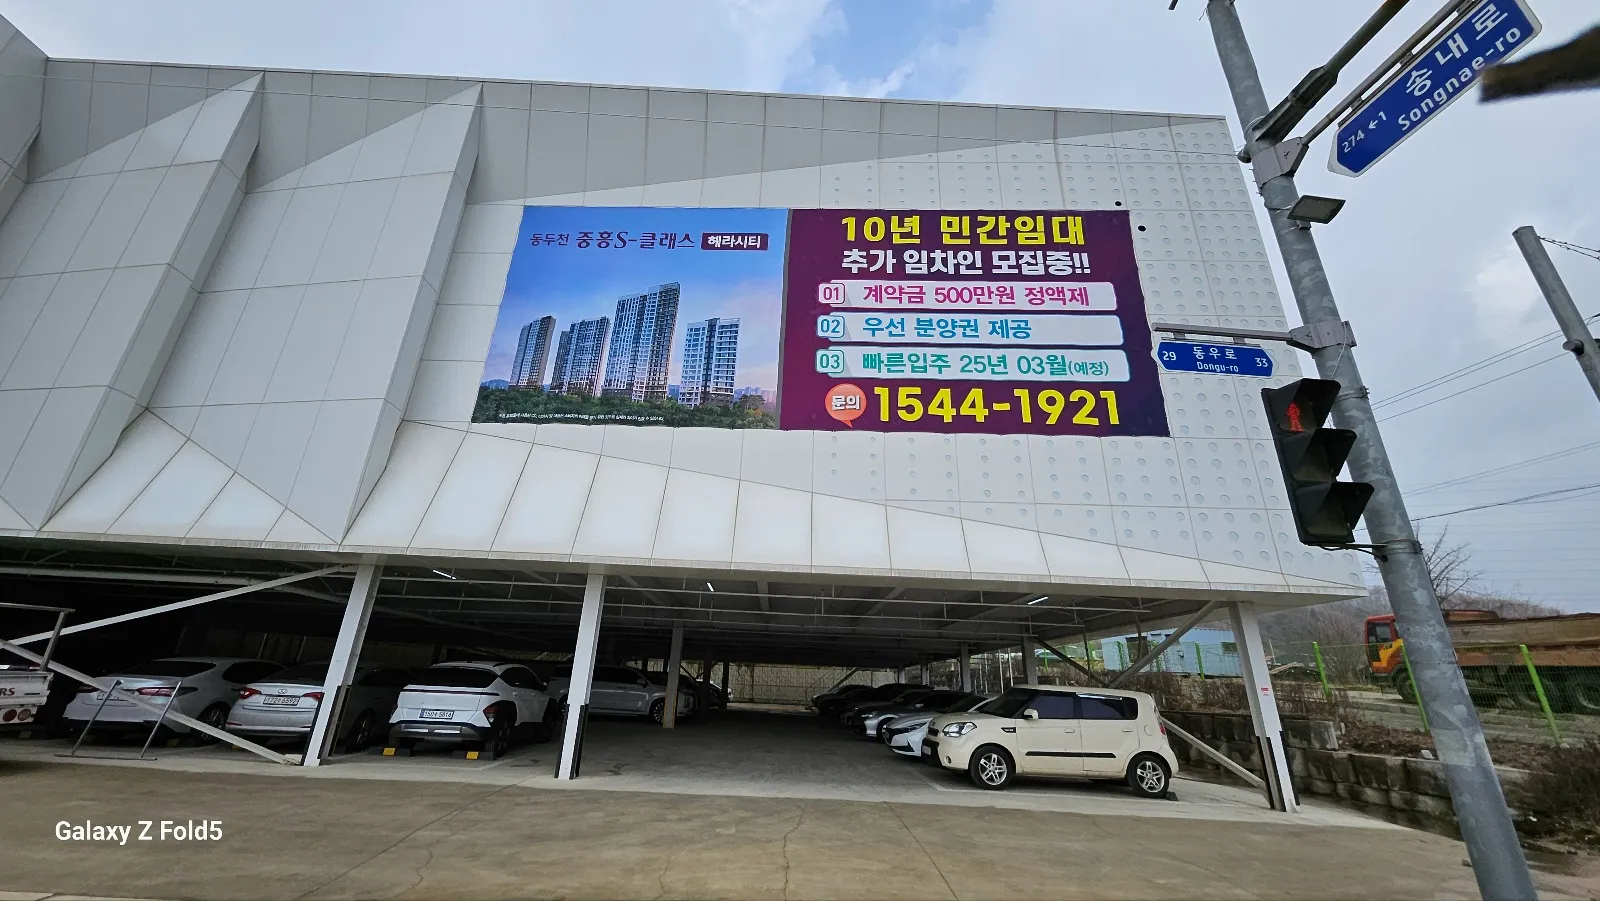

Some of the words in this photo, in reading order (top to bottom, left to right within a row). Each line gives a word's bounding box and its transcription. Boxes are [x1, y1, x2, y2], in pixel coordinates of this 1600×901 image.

[1397, 27, 1521, 131] Songnae-ro
[1341, 129, 1365, 153] 274
[841, 215, 920, 245] 10년
[940, 215, 1085, 246] 민간임대
[529, 233, 569, 247] 동두천
[575, 231, 695, 249] 중흥S-클래스
[841, 249, 896, 274] 추가
[903, 250, 983, 275] 임차인
[992, 250, 1091, 275] 모집중!!
[822, 284, 840, 302] 01
[862, 284, 926, 305] 계약금
[934, 285, 1016, 306] 500만원
[1024, 285, 1089, 307] 정액제
[820, 317, 841, 335] 02
[862, 318, 905, 338] 우선
[913, 319, 980, 339] 분양권
[988, 319, 1031, 339] 제공
[819, 352, 840, 370] 03
[1162, 351, 1177, 361] 29
[1193, 346, 1238, 360] 동우로
[862, 352, 951, 375] 빠른입주
[959, 354, 1008, 375] 25년
[1196, 361, 1239, 373] Dongu-ro
[1254, 357, 1269, 368] 33
[831, 394, 861, 411] 문의
[874, 386, 1120, 426] 1544-1921
